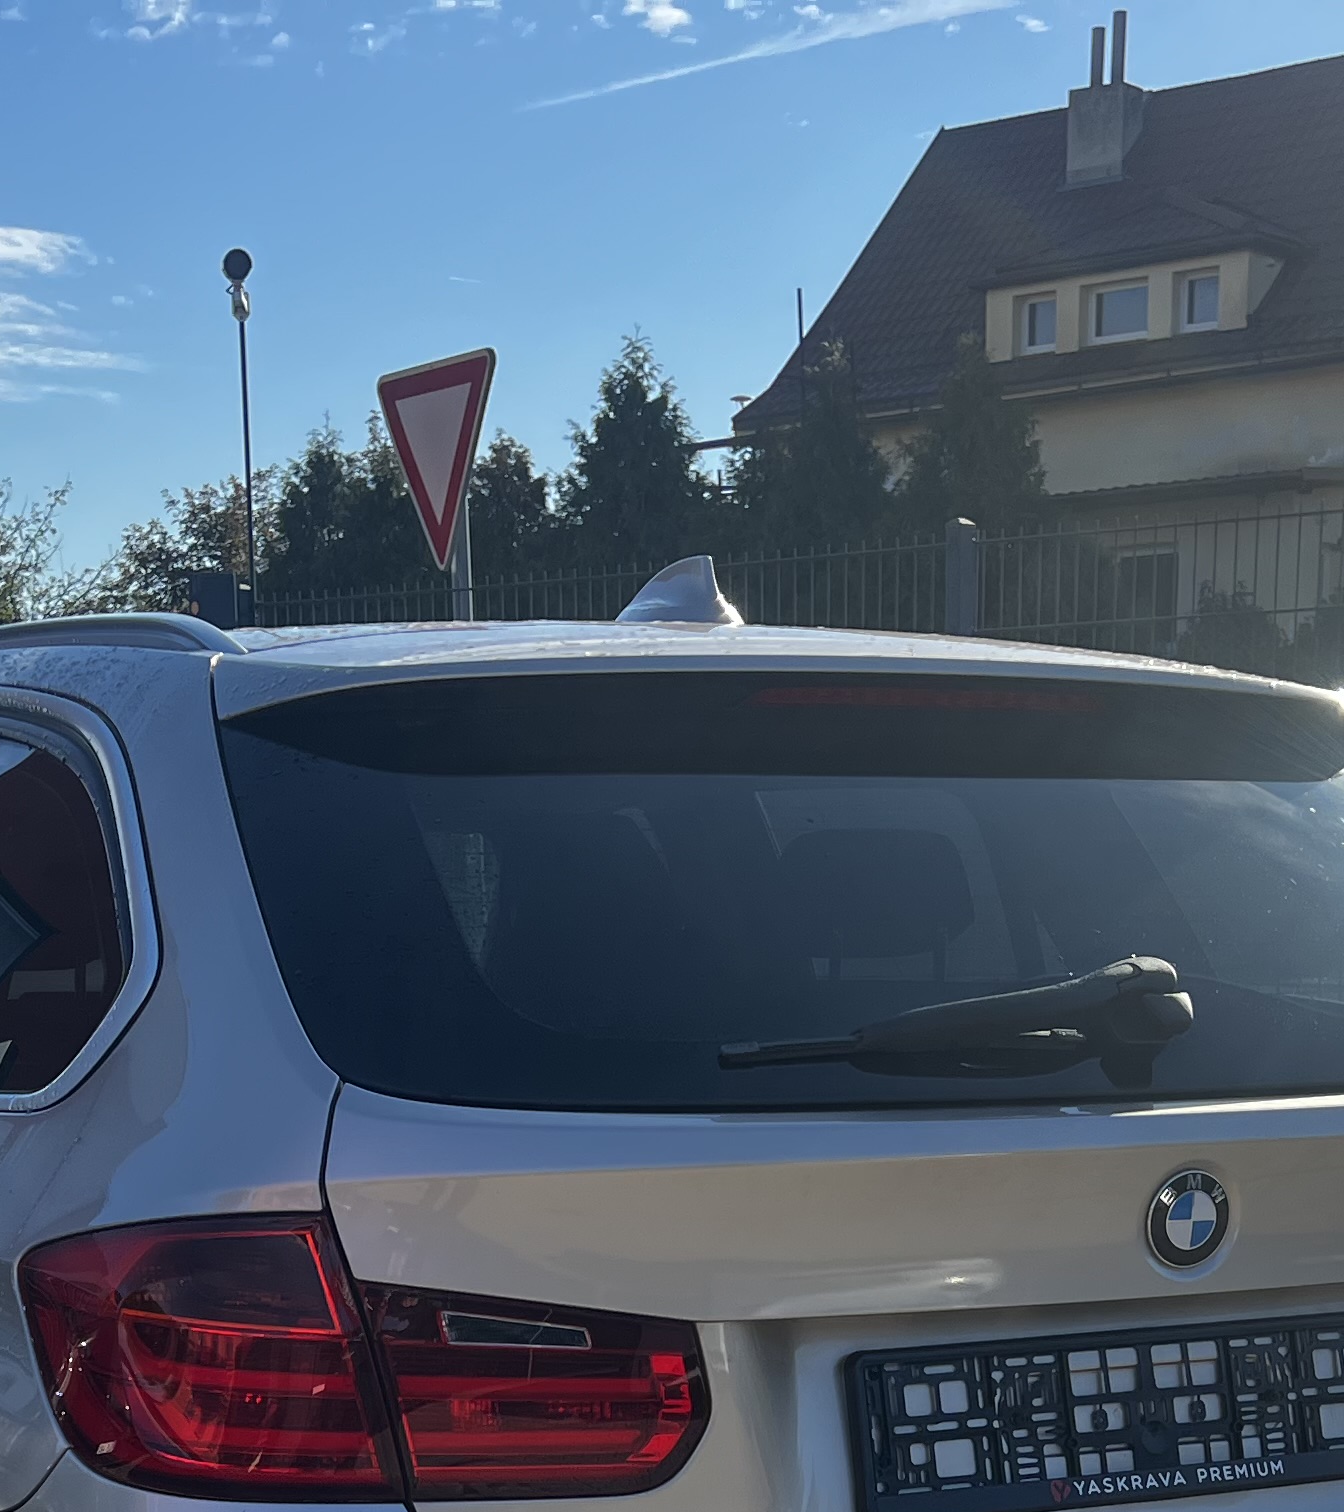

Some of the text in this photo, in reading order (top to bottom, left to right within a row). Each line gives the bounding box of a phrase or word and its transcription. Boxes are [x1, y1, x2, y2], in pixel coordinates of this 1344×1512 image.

[1159, 1174, 1225, 1207] BMW
[1072, 1459, 1285, 1497] YASKRAVA PREMIUM
